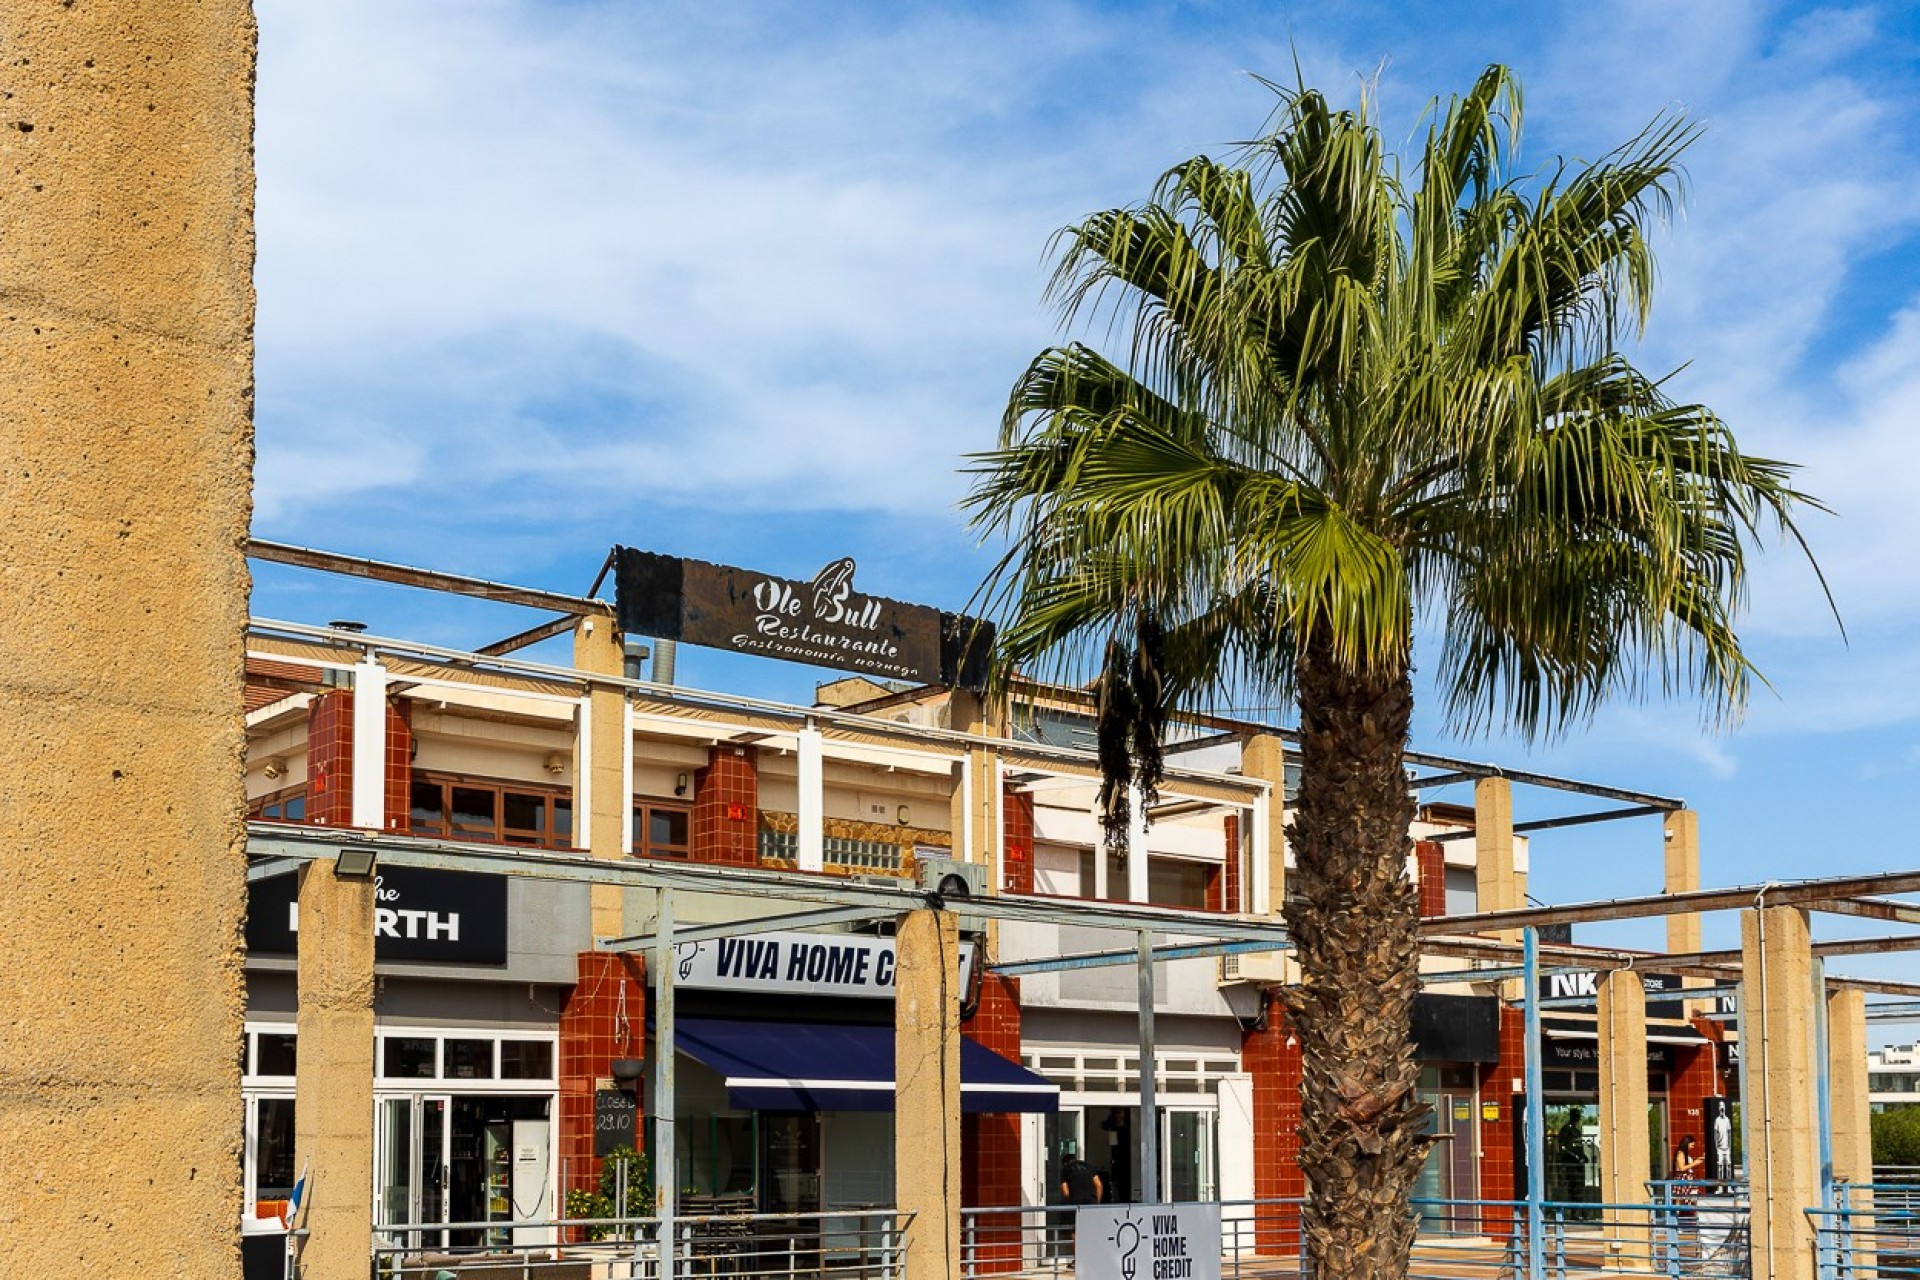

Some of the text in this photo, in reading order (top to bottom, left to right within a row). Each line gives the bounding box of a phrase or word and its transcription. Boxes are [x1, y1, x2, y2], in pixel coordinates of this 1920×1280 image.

[754, 575, 882, 630] Ole Bull
[755, 614, 898, 659] Restaurante
[854, 658, 918, 676] noruega
[374, 875, 400, 901] he
[716, 937, 780, 980] VIVA
[786, 942, 871, 985] HOME
[1555, 1047, 1572, 1058] Your
[595, 1113, 631, 1131] 29.10
[1151, 1214, 1178, 1235] VIVA
[1152, 1236, 1187, 1258] HOME
[1152, 1257, 1193, 1280] CREDIT
